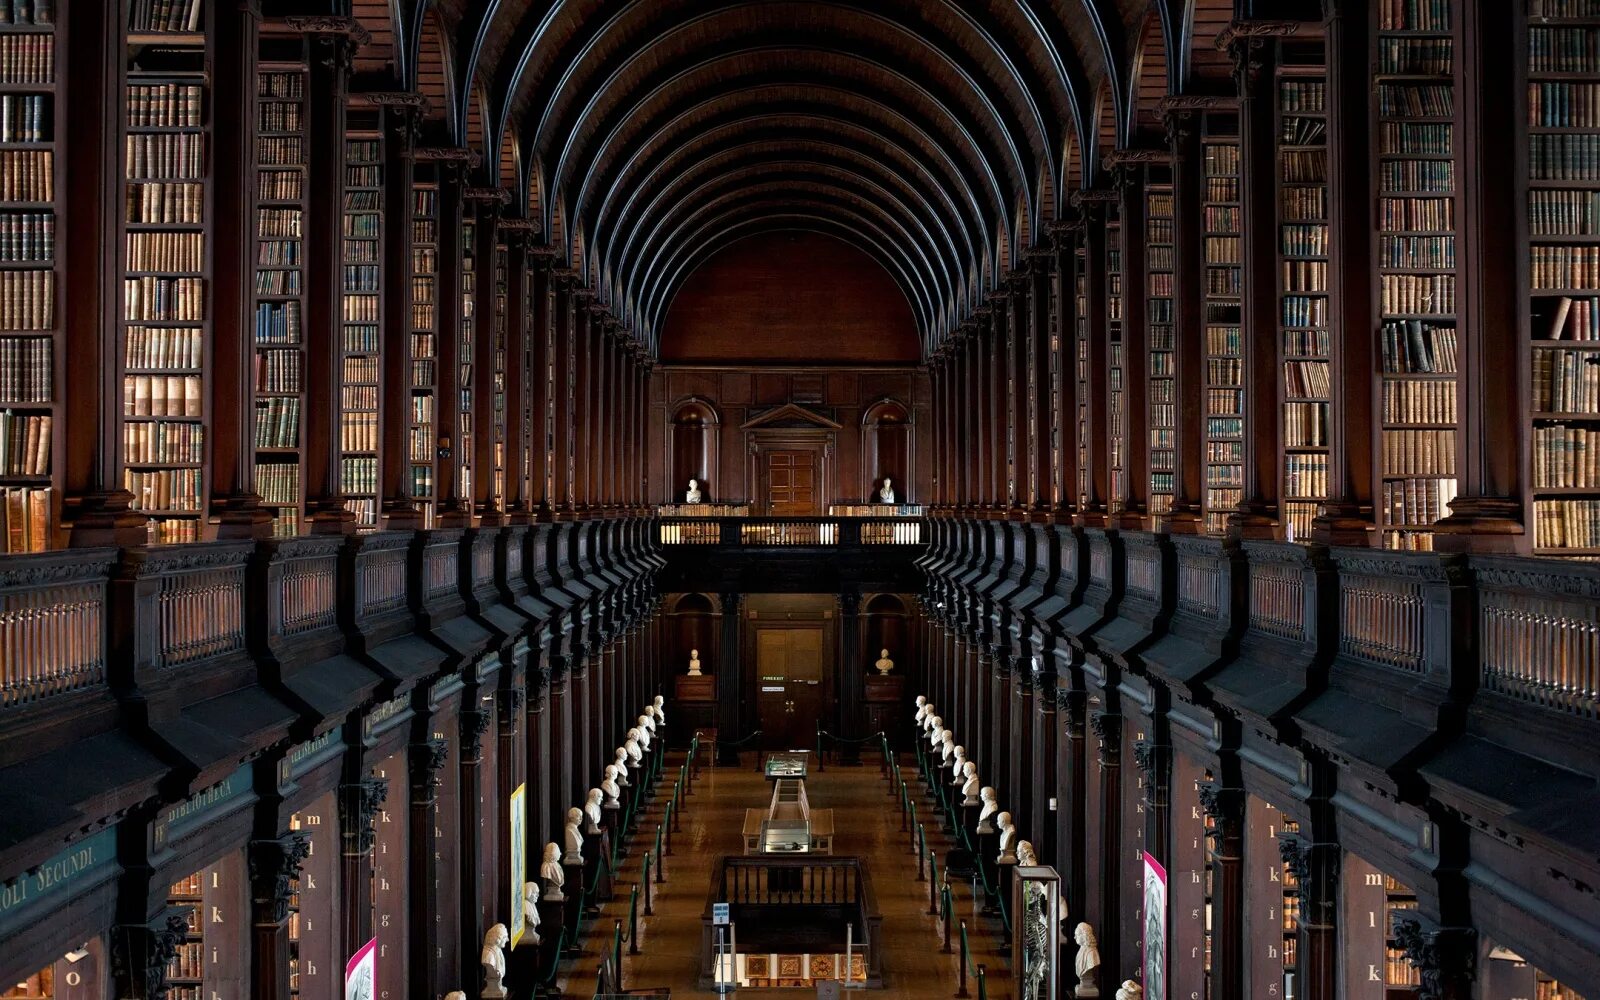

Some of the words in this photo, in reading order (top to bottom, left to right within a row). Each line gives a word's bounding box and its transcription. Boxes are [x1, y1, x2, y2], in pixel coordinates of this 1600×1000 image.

[1136, 804, 1144, 813] k
[1192, 806, 1200, 819] k
[307, 815, 321, 825] m
[382, 810, 391, 823] k
[382, 842, 387, 854] i
[1193, 837, 1197, 849] i
[1192, 870, 1200, 883] h
[1269, 867, 1280, 882] k
[1365, 873, 1382, 886] m
[307, 874, 316, 889] k
[381, 878, 390, 890] h
[0, 879, 27, 911] OLI
[212, 906, 224, 923] k
[1269, 906, 1275, 920] i
[307, 918, 313, 931] i
[381, 914, 390, 927] g
[212, 946, 218, 964] i
[381, 944, 388, 957] f
[1191, 946, 1198, 958] f
[1268, 945, 1277, 959] h
[307, 960, 317, 975] h
[1368, 964, 1381, 981] k
[381, 990, 389, 999] e
[1191, 991, 1198, 1000] e
[1268, 982, 1278, 996] g
